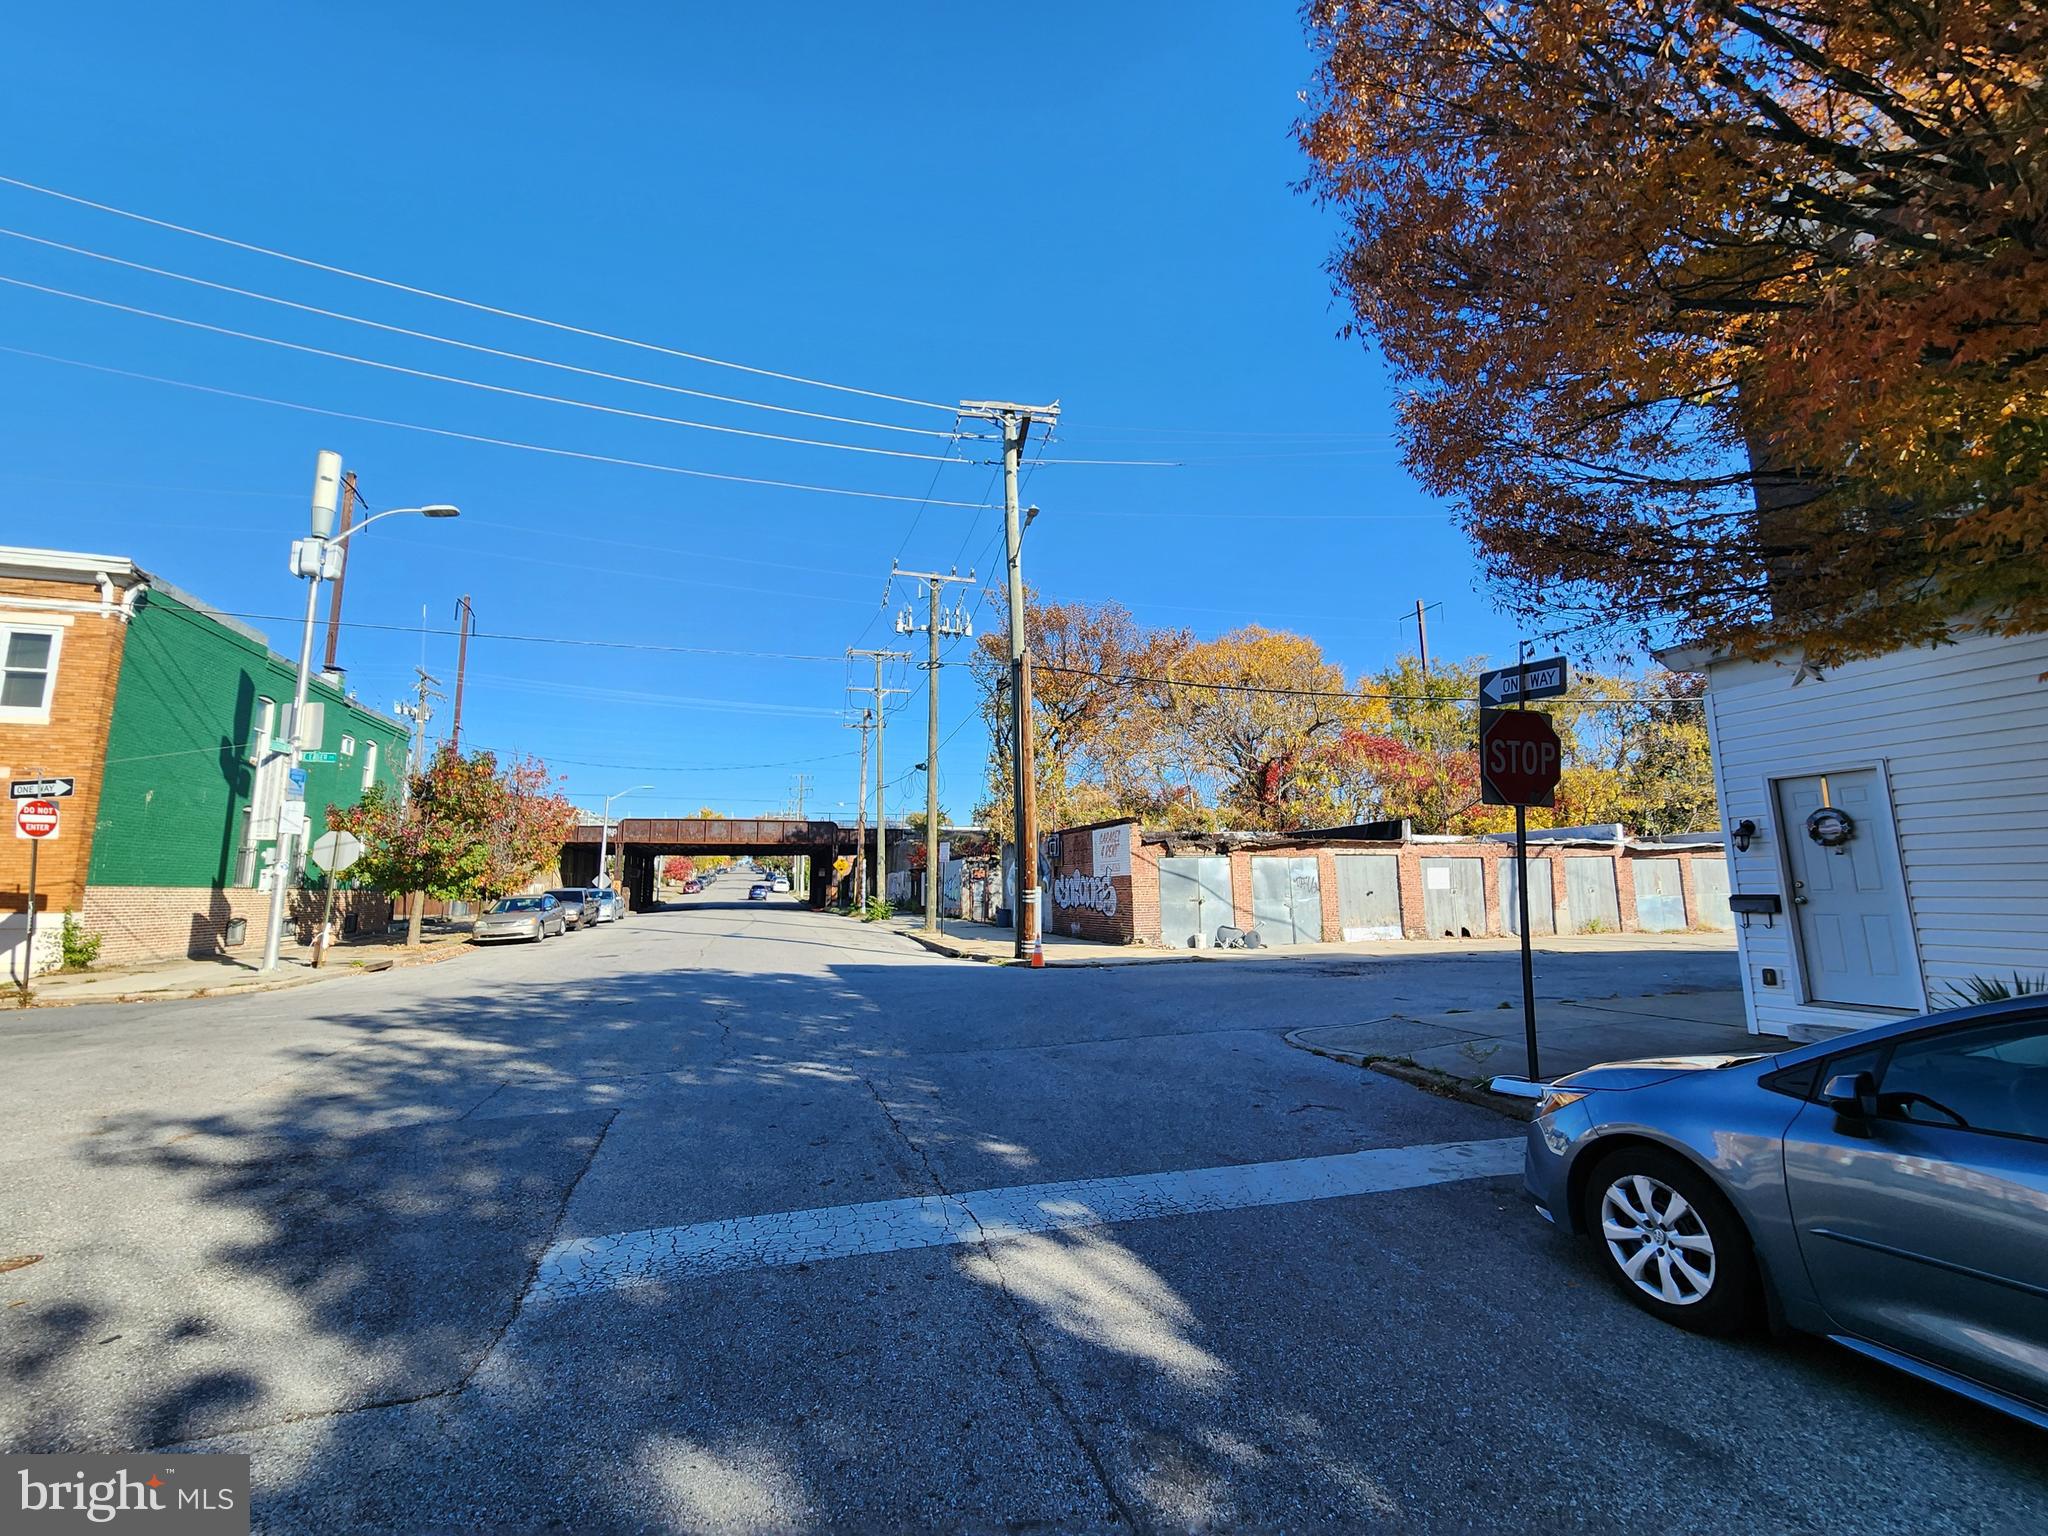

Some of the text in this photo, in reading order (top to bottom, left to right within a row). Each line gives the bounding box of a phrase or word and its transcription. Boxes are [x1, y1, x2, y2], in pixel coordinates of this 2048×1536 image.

[1503, 669, 1556, 692] ON WAY
[1490, 739, 1556, 776] STOP
[17, 785, 33, 793] ONE
